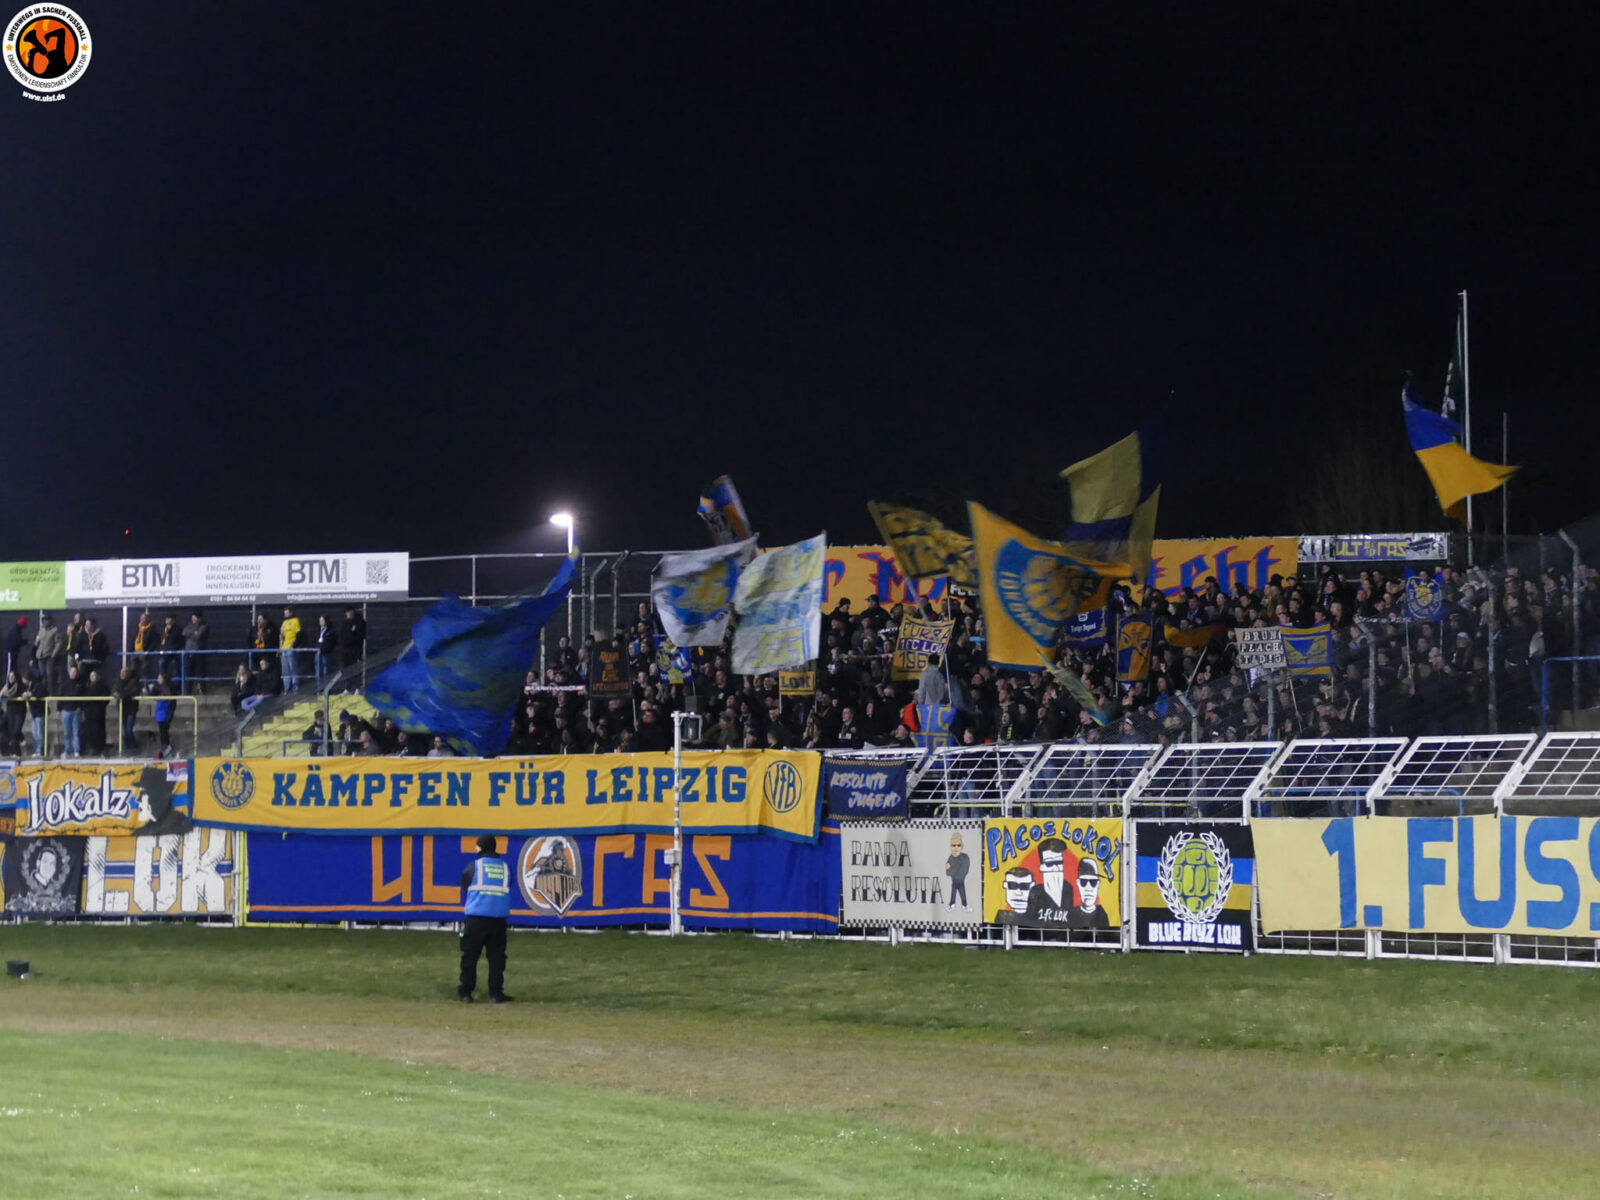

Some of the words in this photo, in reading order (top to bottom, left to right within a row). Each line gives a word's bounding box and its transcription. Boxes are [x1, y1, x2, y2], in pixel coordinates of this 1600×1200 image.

[122, 564, 173, 588] BTM
[205, 573, 262, 581] BRANDSCHUTZ
[206, 564, 261, 572] TROCKENBAU
[287, 559, 340, 584] BTM
[205, 582, 261, 590] INNENAUSBAU
[271, 765, 471, 807] KÄMPFEN
[488, 762, 565, 806] FÜR
[586, 766, 747, 805] LEIPZIG
[851, 840, 912, 867] BANDA
[986, 820, 1056, 872] PACOS
[1320, 817, 1383, 929] 1.
[1407, 816, 1600, 931] FUS
[851, 875, 944, 904] RESOLUTA
[1148, 922, 1181, 942] BLUE
